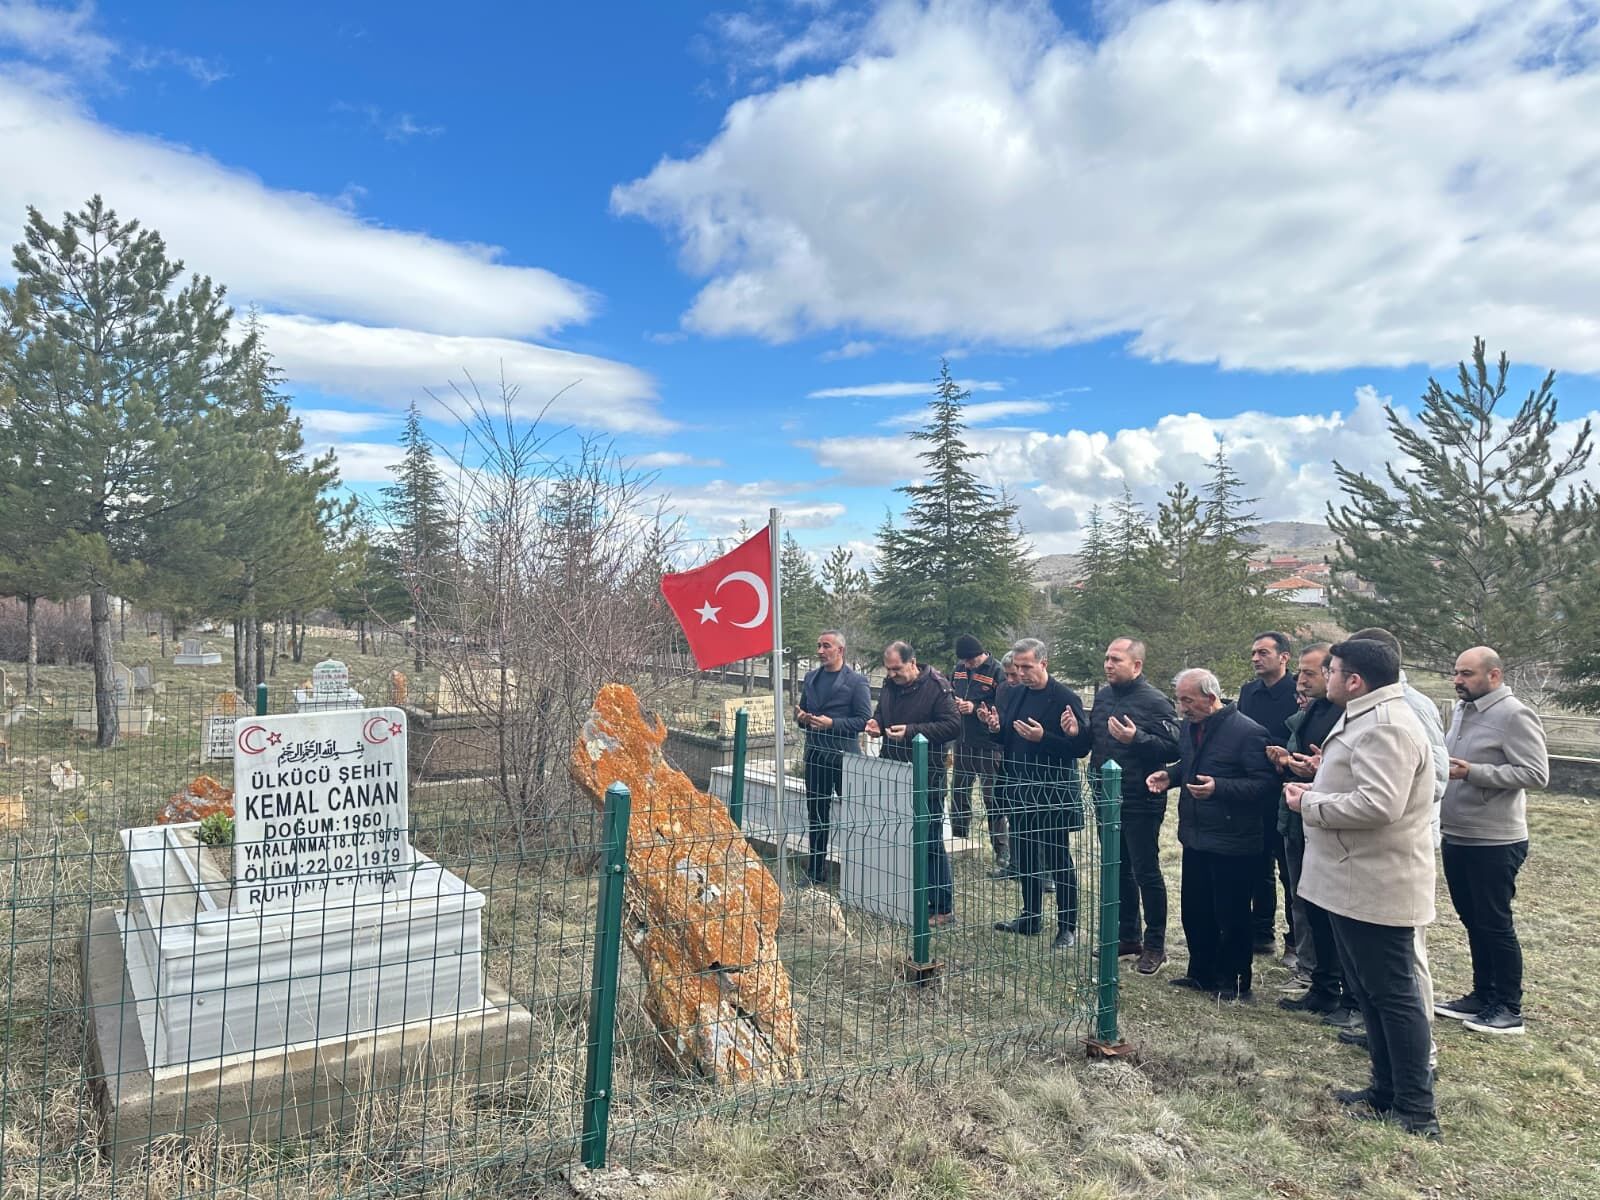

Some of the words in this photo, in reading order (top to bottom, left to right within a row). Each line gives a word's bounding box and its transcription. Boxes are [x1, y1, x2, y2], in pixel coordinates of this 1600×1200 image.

[251, 765, 331, 790] ÜLKÜCÜ
[338, 760, 393, 785] ŞEHİT
[245, 789, 320, 821] KEMAL
[327, 781, 399, 812] CANAN
